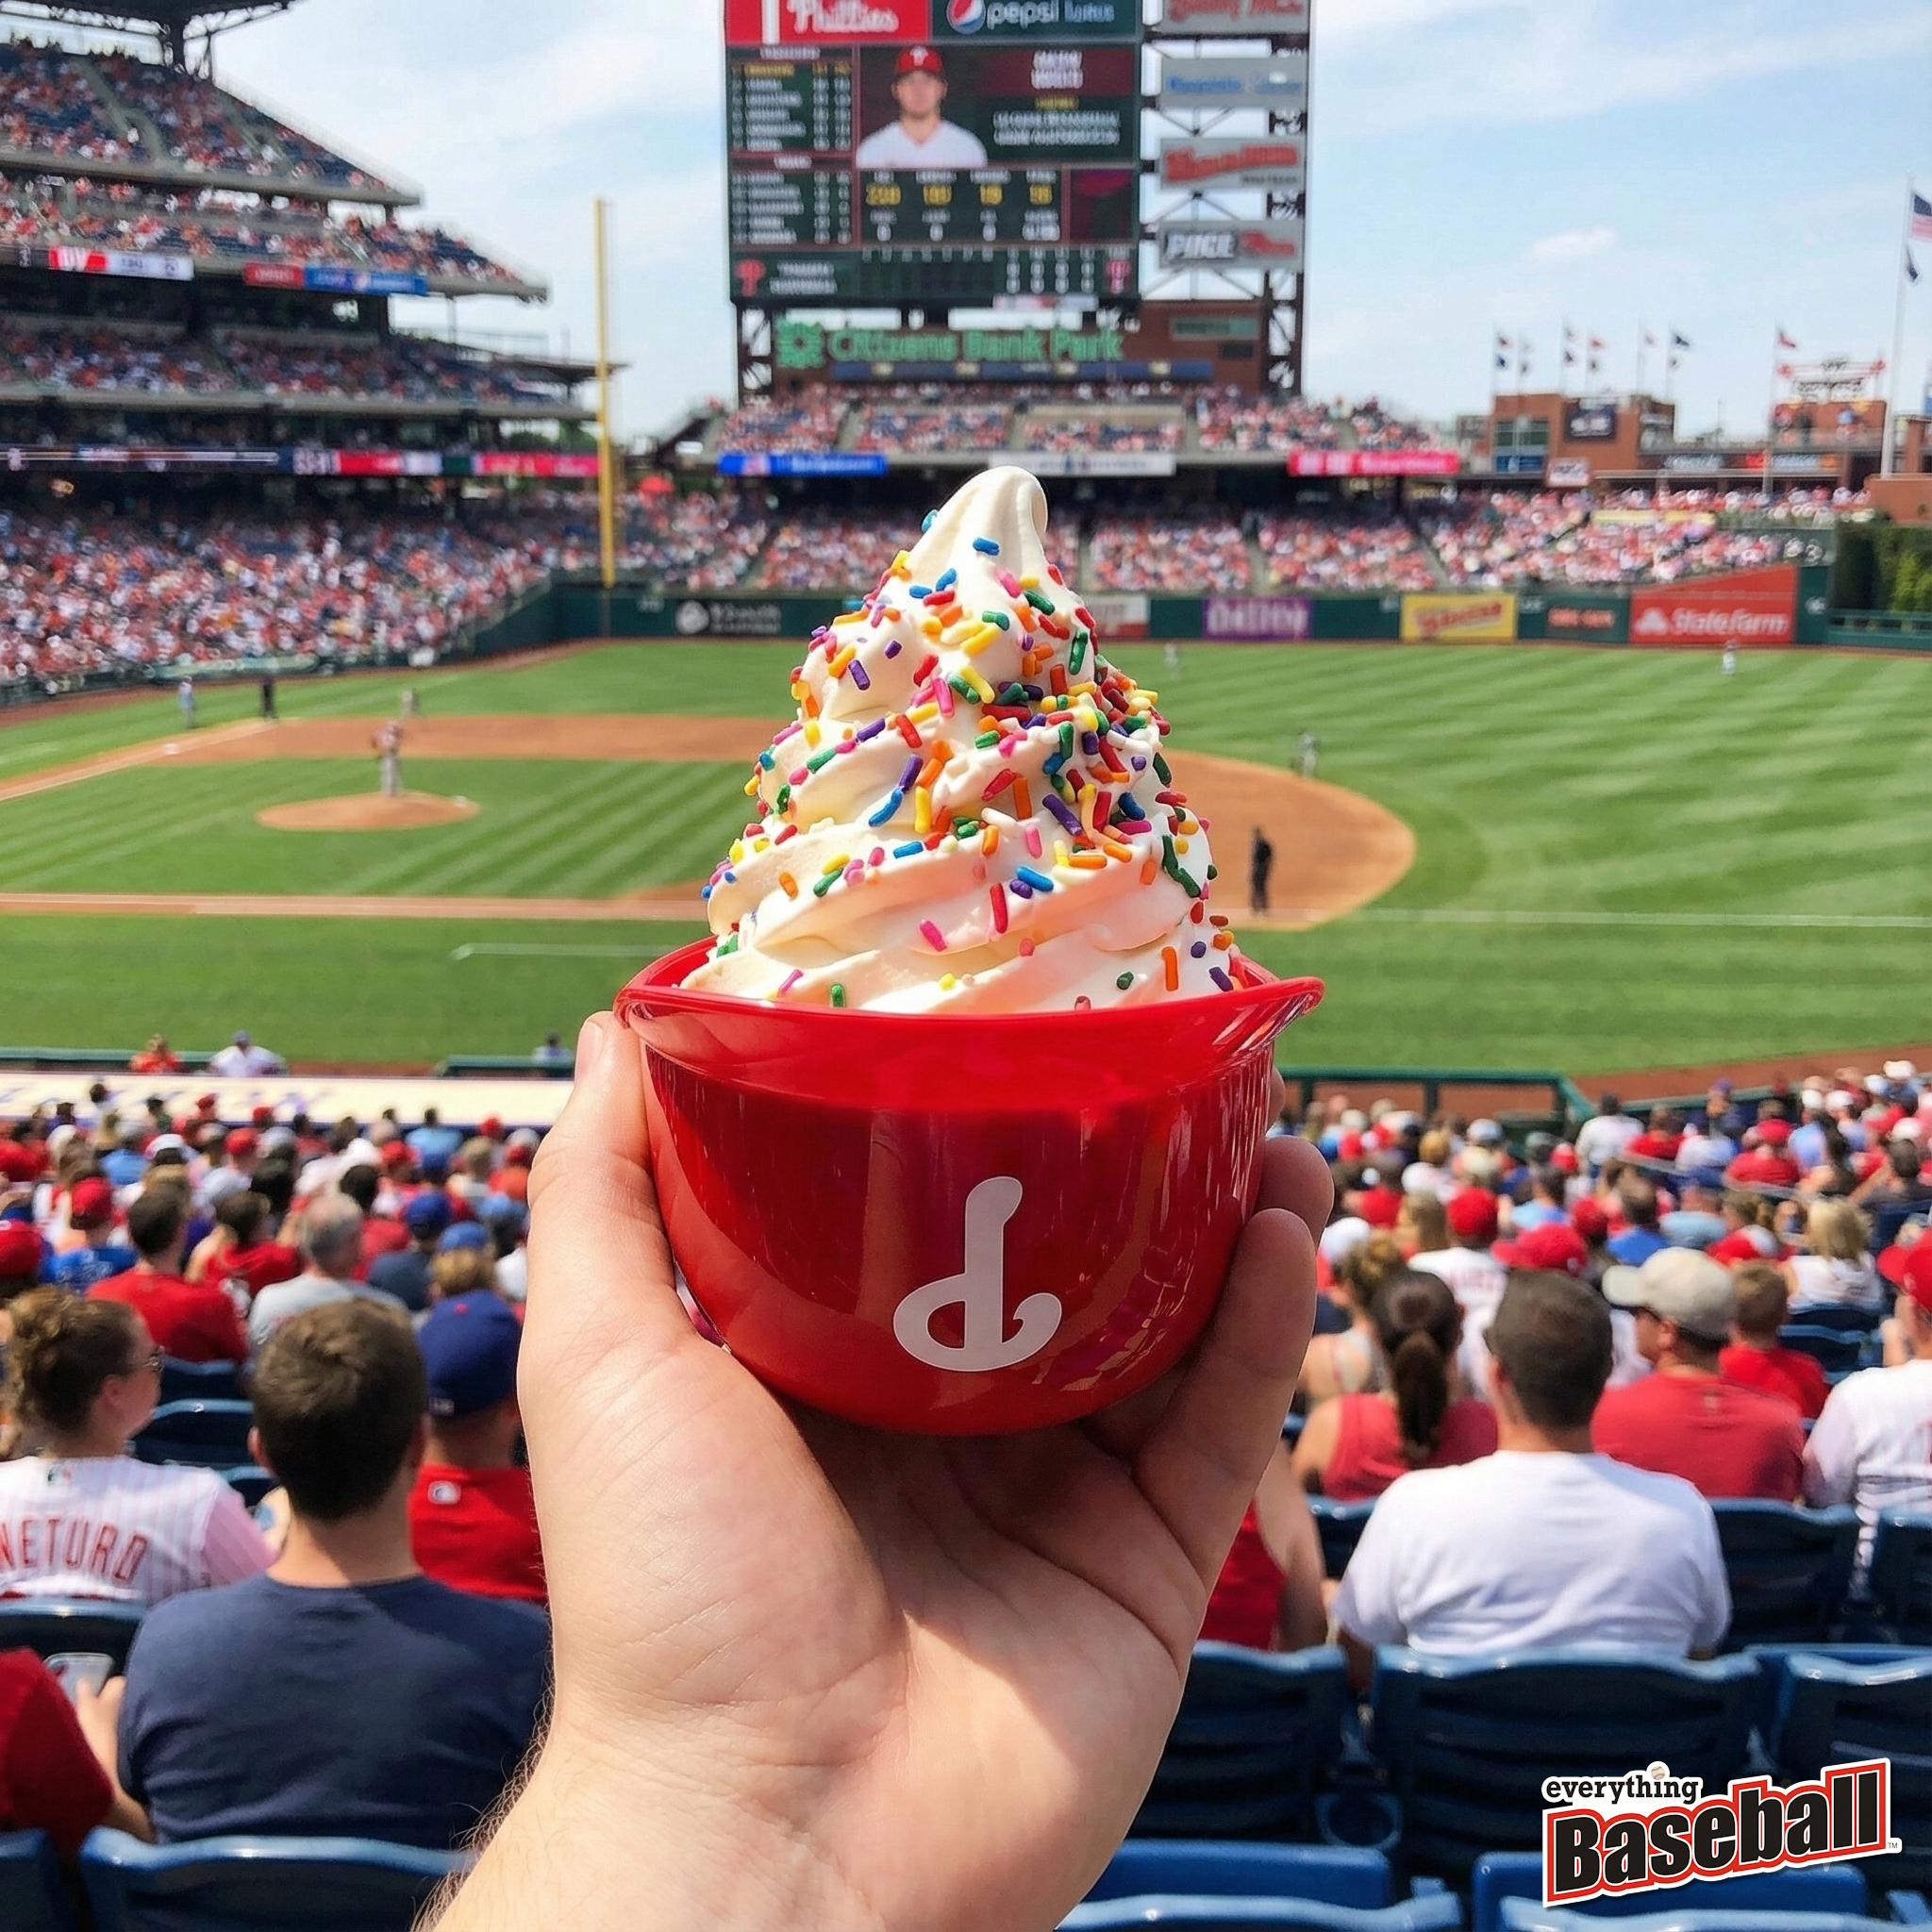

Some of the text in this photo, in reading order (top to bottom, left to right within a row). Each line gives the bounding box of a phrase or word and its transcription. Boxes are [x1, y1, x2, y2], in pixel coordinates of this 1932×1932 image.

[987, 0, 1059, 30] pepsi
[827, 327, 1124, 361] Citizens Bank Park
